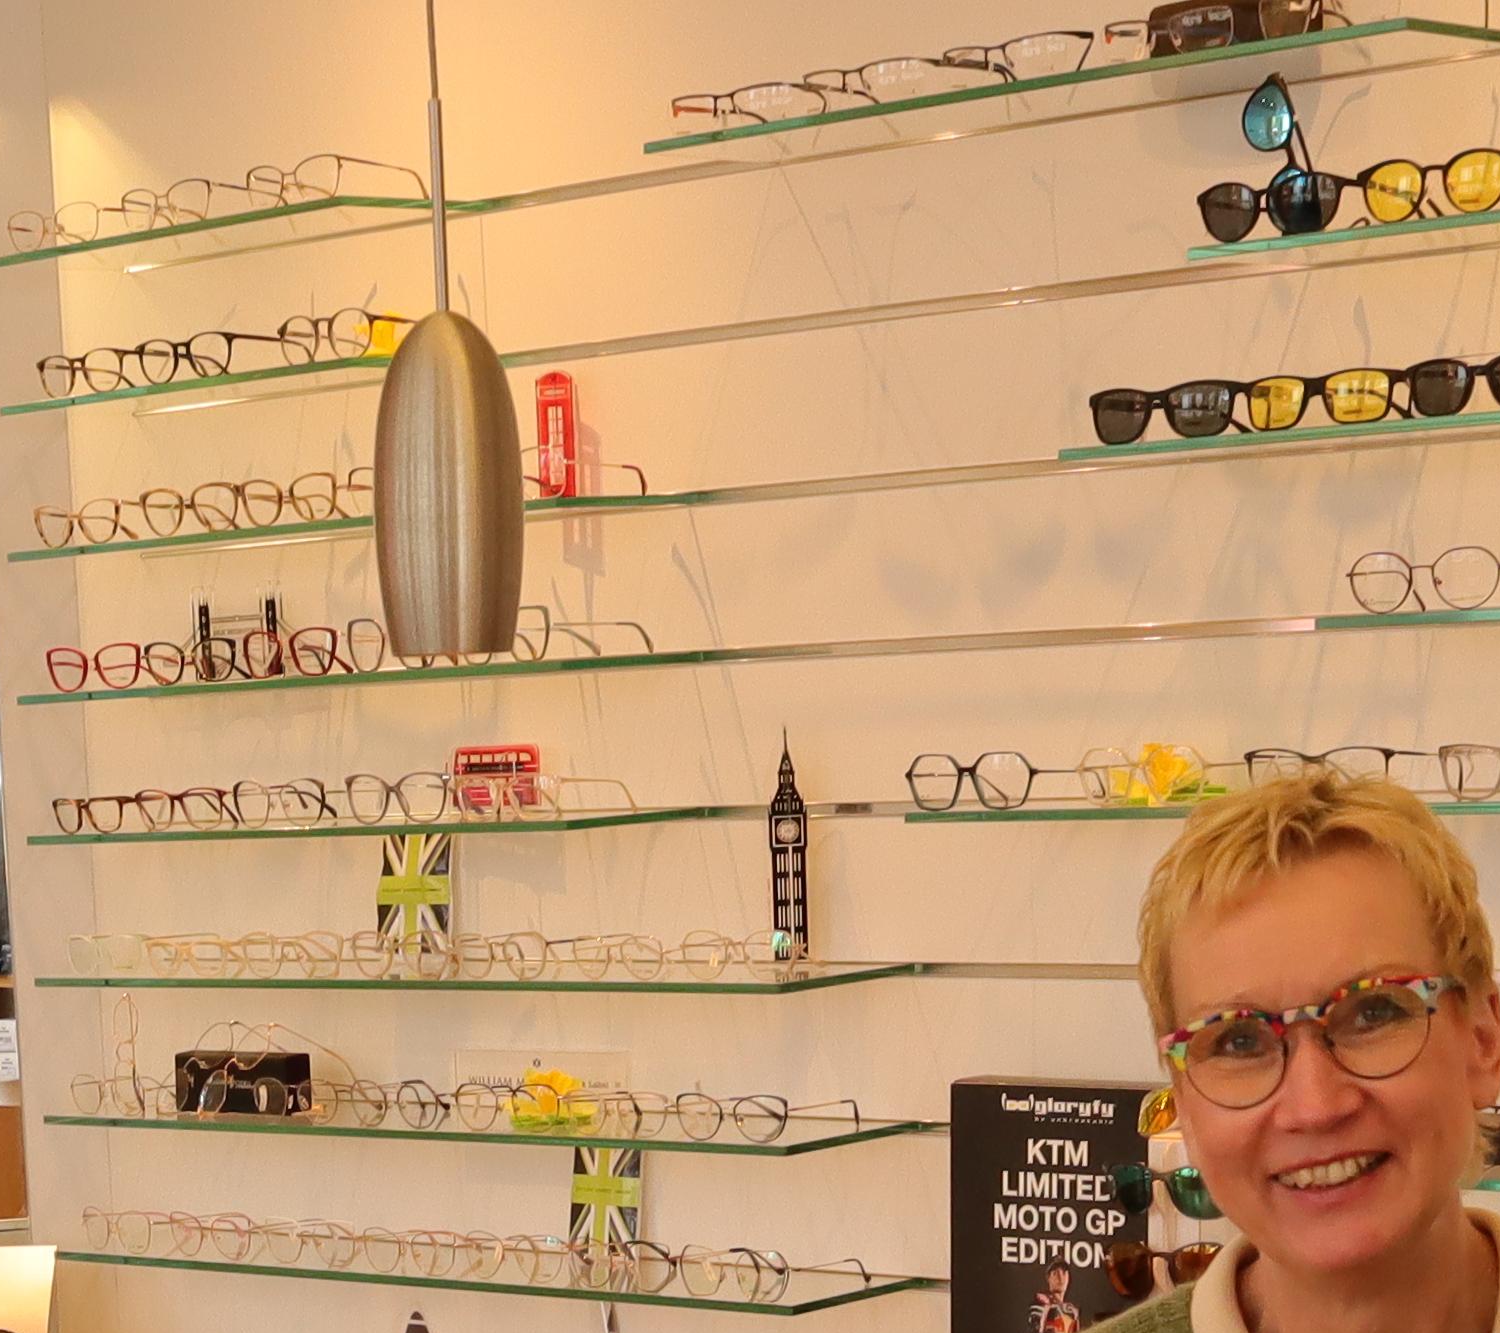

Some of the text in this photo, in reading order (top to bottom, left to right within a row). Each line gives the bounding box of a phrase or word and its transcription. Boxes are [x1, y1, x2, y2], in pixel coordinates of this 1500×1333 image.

[1027, 1138, 1089, 1167] KTM
[993, 1203, 1126, 1236] MOTO GP
